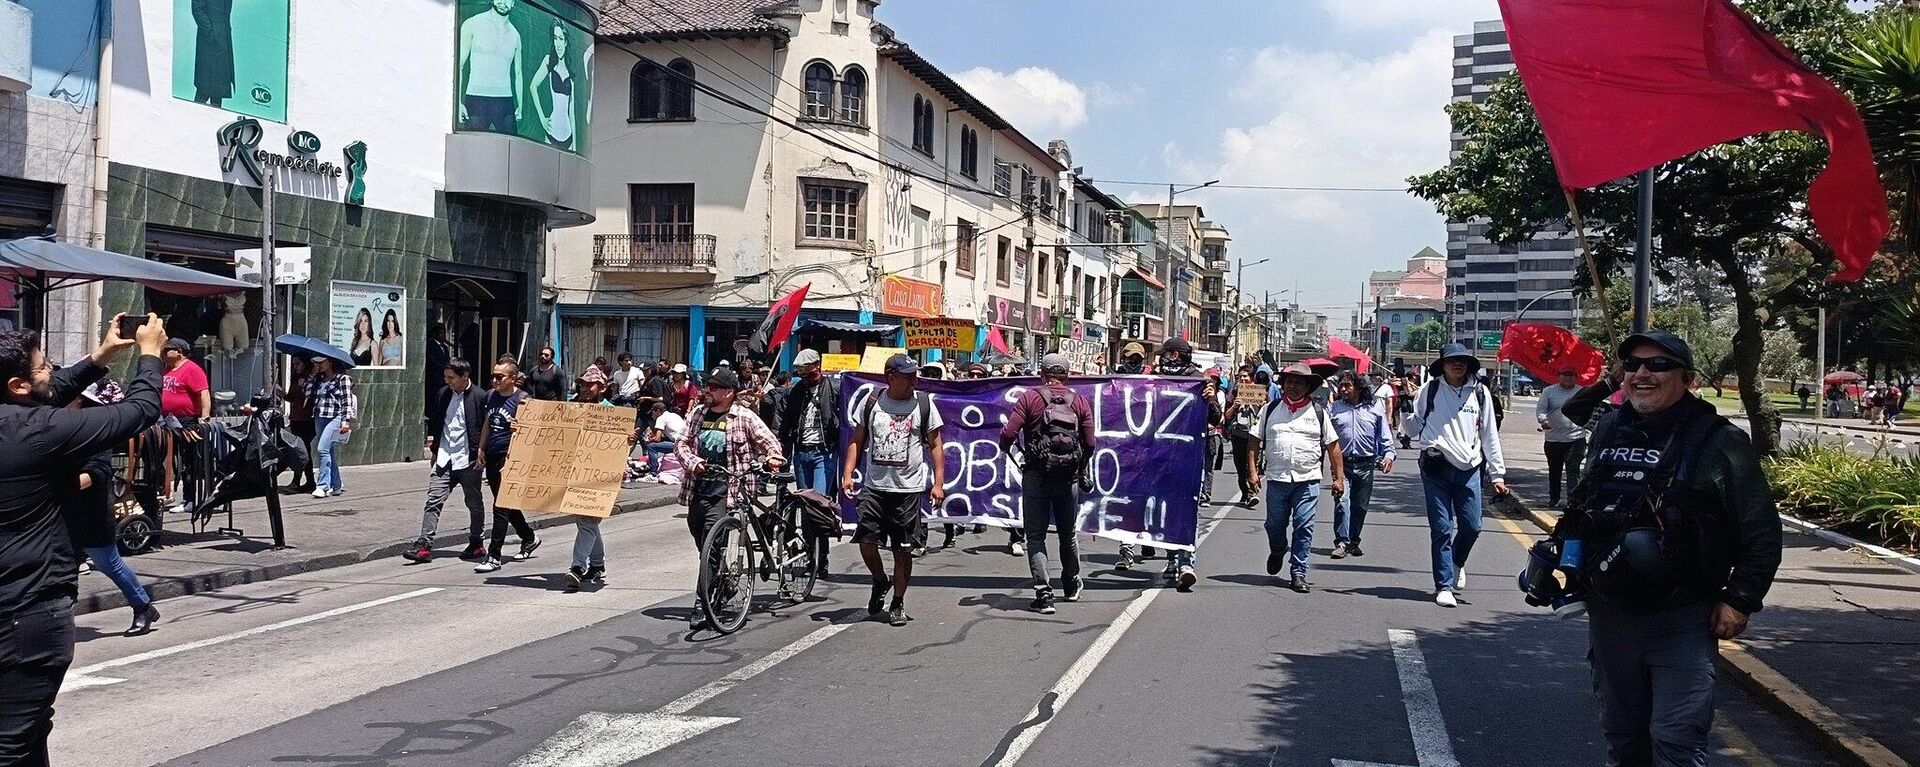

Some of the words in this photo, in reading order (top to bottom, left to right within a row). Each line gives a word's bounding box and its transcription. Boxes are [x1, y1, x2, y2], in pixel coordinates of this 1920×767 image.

[905, 319, 921, 328] NO
[906, 329, 917, 338] LA
[918, 327, 945, 338] FALTA
[947, 328, 958, 338] DE
[908, 336, 959, 349] DERECHOS
[1094, 383, 1194, 443] LUZ
[513, 425, 566, 447] FUERA
[573, 429, 628, 452] NOBOA
[548, 449, 593, 466] FUERA
[507, 482, 552, 499] FUERA
[1607, 545, 1620, 562] AFP
